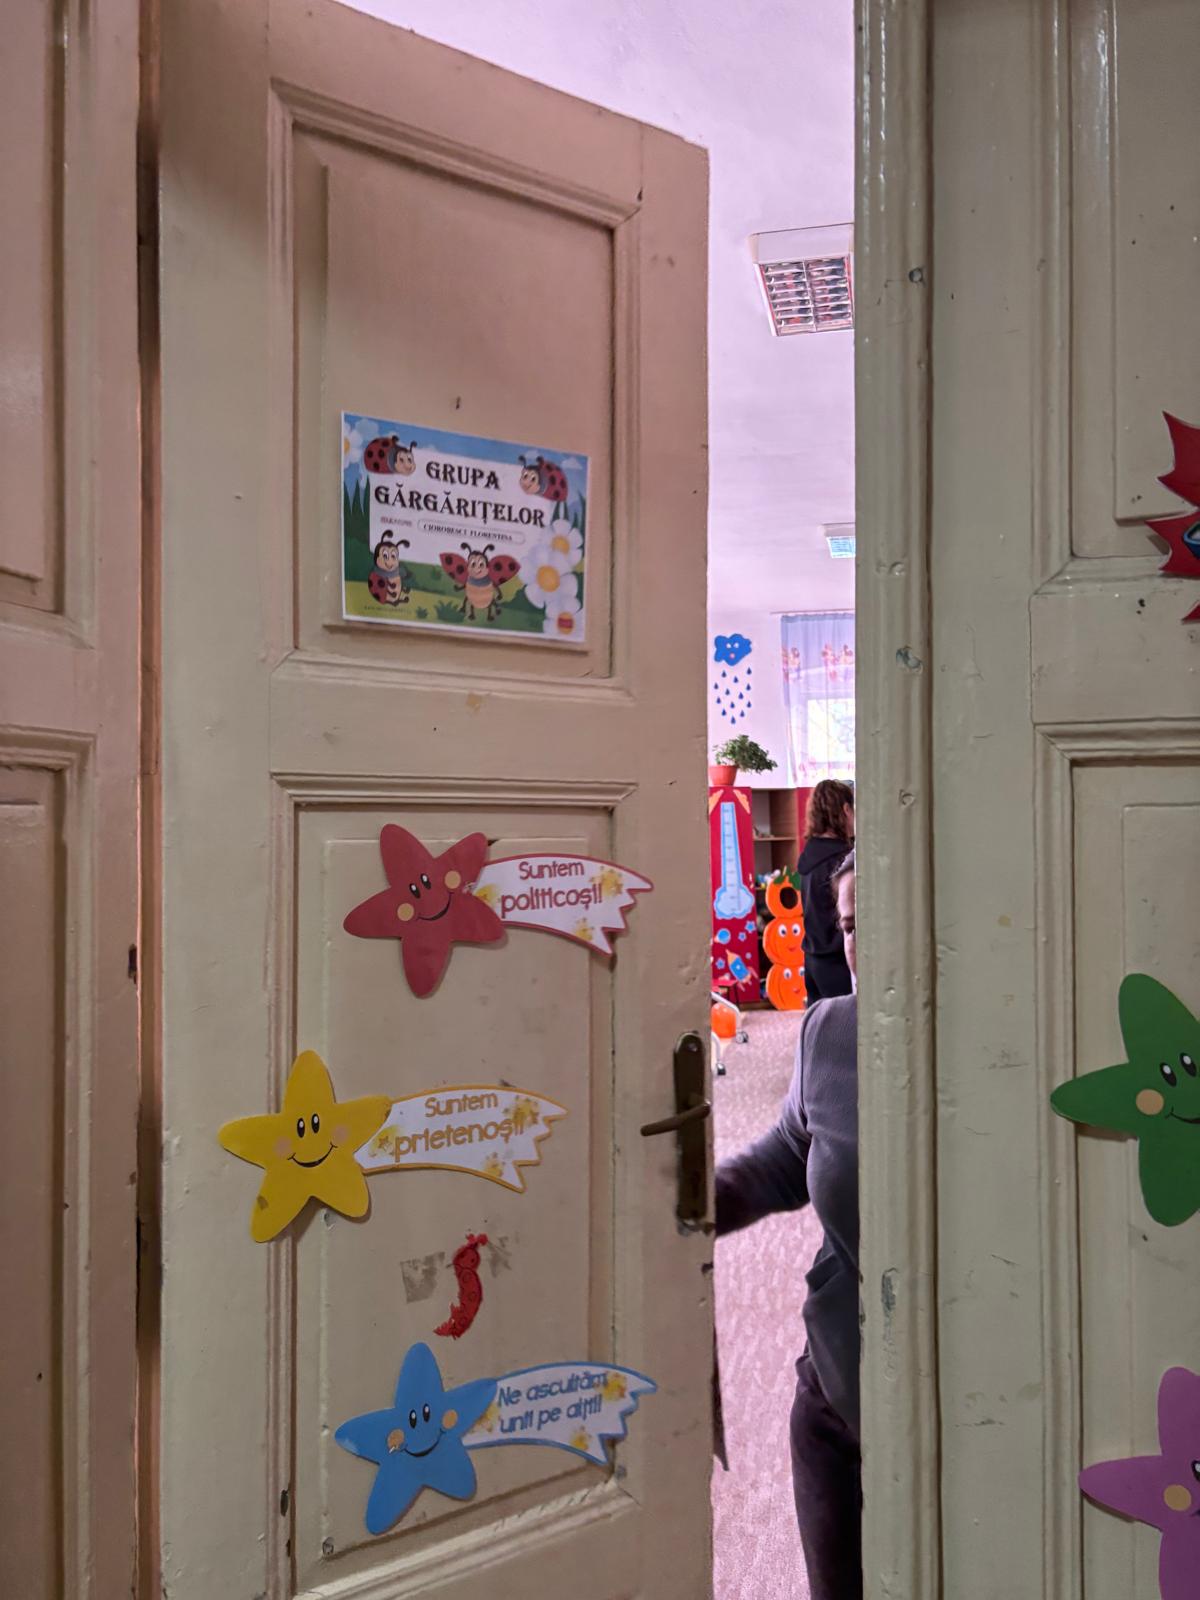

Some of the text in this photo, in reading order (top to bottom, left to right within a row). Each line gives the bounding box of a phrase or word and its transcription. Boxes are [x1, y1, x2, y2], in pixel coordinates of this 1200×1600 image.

[426, 460, 501, 490] GRUPA
[374, 483, 546, 528] GĂRGĂRIȚELOR
[518, 860, 585, 881] Suntem
[425, 1092, 499, 1118] Suntem
[497, 1370, 609, 1408] Ne ascultăm
[499, 1410, 533, 1434] unii
[537, 1408, 561, 1431] pe
